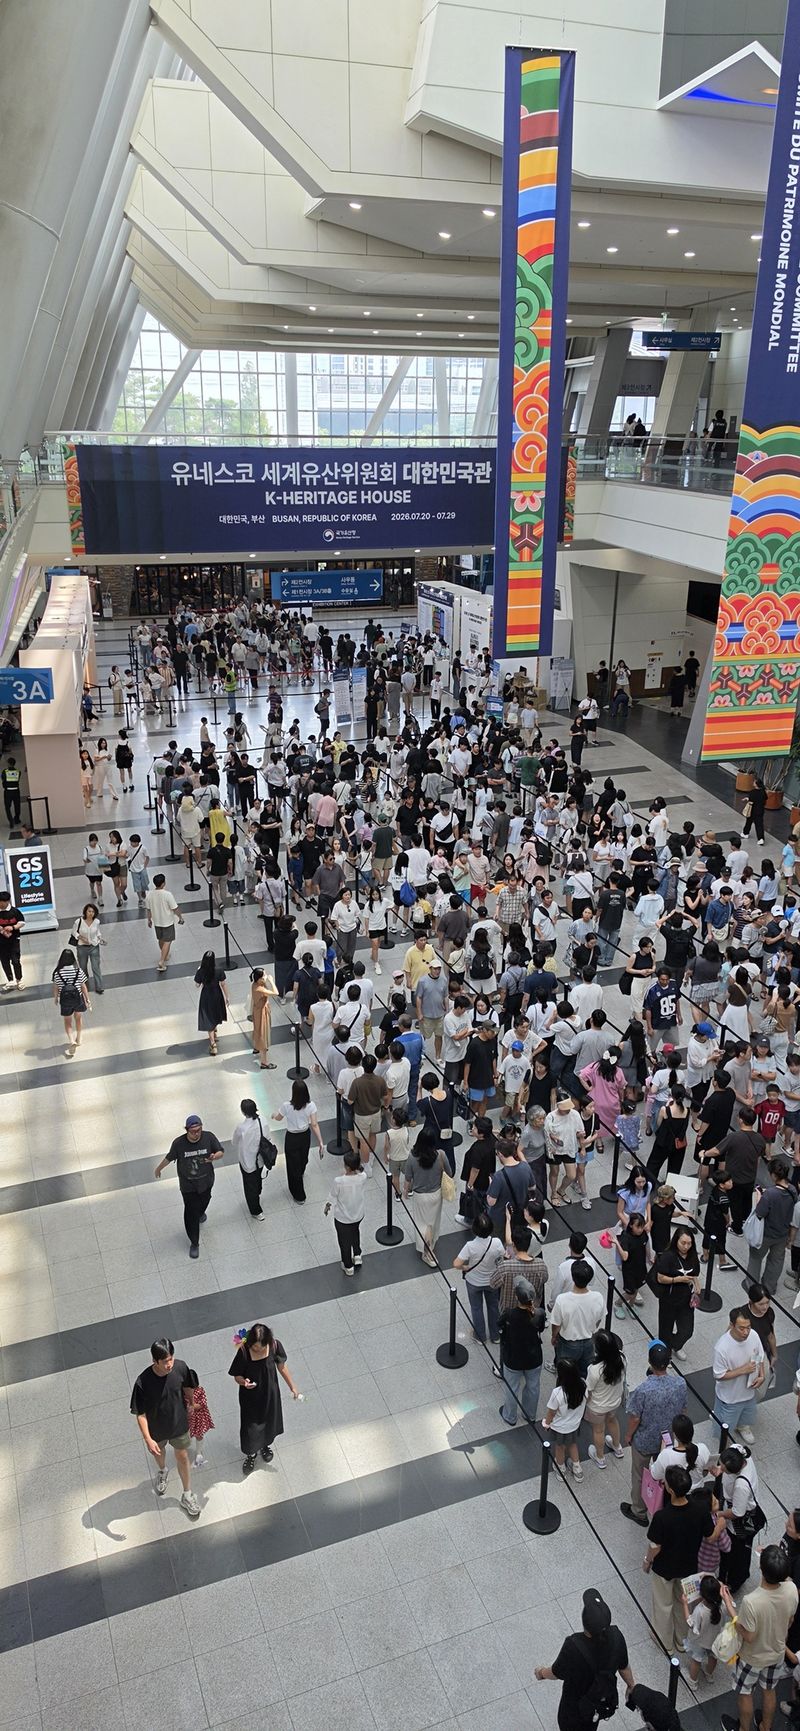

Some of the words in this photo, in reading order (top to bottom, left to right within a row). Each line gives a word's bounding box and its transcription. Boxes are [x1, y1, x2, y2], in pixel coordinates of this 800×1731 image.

[777, 164, 799, 269] PATRIMOINE
[768, 273, 787, 351] MONDIAL
[171, 461, 255, 486] 유네스코
[261, 461, 397, 486] 세계유산위원회
[402, 461, 492, 485] 대한민국관
[265, 490, 358, 505] K-HERITAGE
[360, 490, 412, 504] HOUSE
[219, 514, 250, 524] 대한민국,
[251, 514, 265, 523] 부산
[272, 514, 301, 524] BUSAN,
[302, 514, 339, 522] REPUBLIC
[340, 513, 351, 521] OF
[352, 513, 377, 521] KOREA
[390, 512, 431, 520] 2026.07.20
[12, 680, 47, 701] 3A
[16, 856, 43, 873] GS
[18, 871, 44, 888] 25
[660, 994, 676, 1016] 85
[764, 1112, 780, 1125] 08
